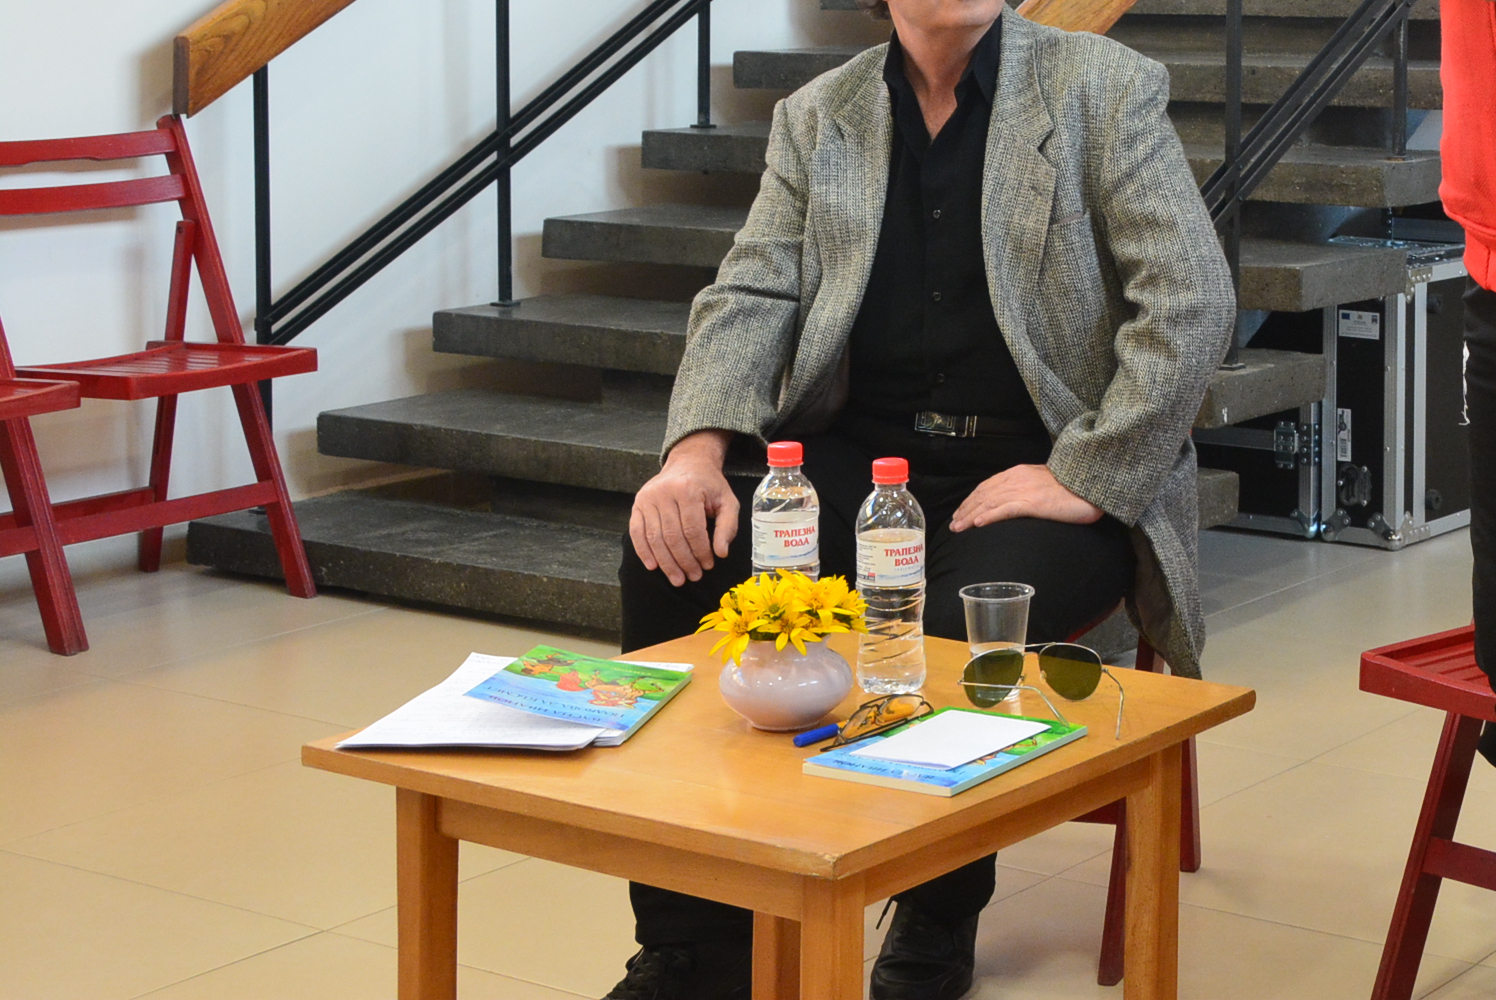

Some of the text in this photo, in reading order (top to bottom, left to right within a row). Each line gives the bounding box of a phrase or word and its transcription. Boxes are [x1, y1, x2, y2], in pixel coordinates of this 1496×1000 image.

[773, 525, 816, 538] ТРАПЕЗНА
[784, 537, 810, 548] ВОДА
[884, 544, 923, 557] ТРАПЕЗНА
[895, 555, 919, 567] ВОДА
